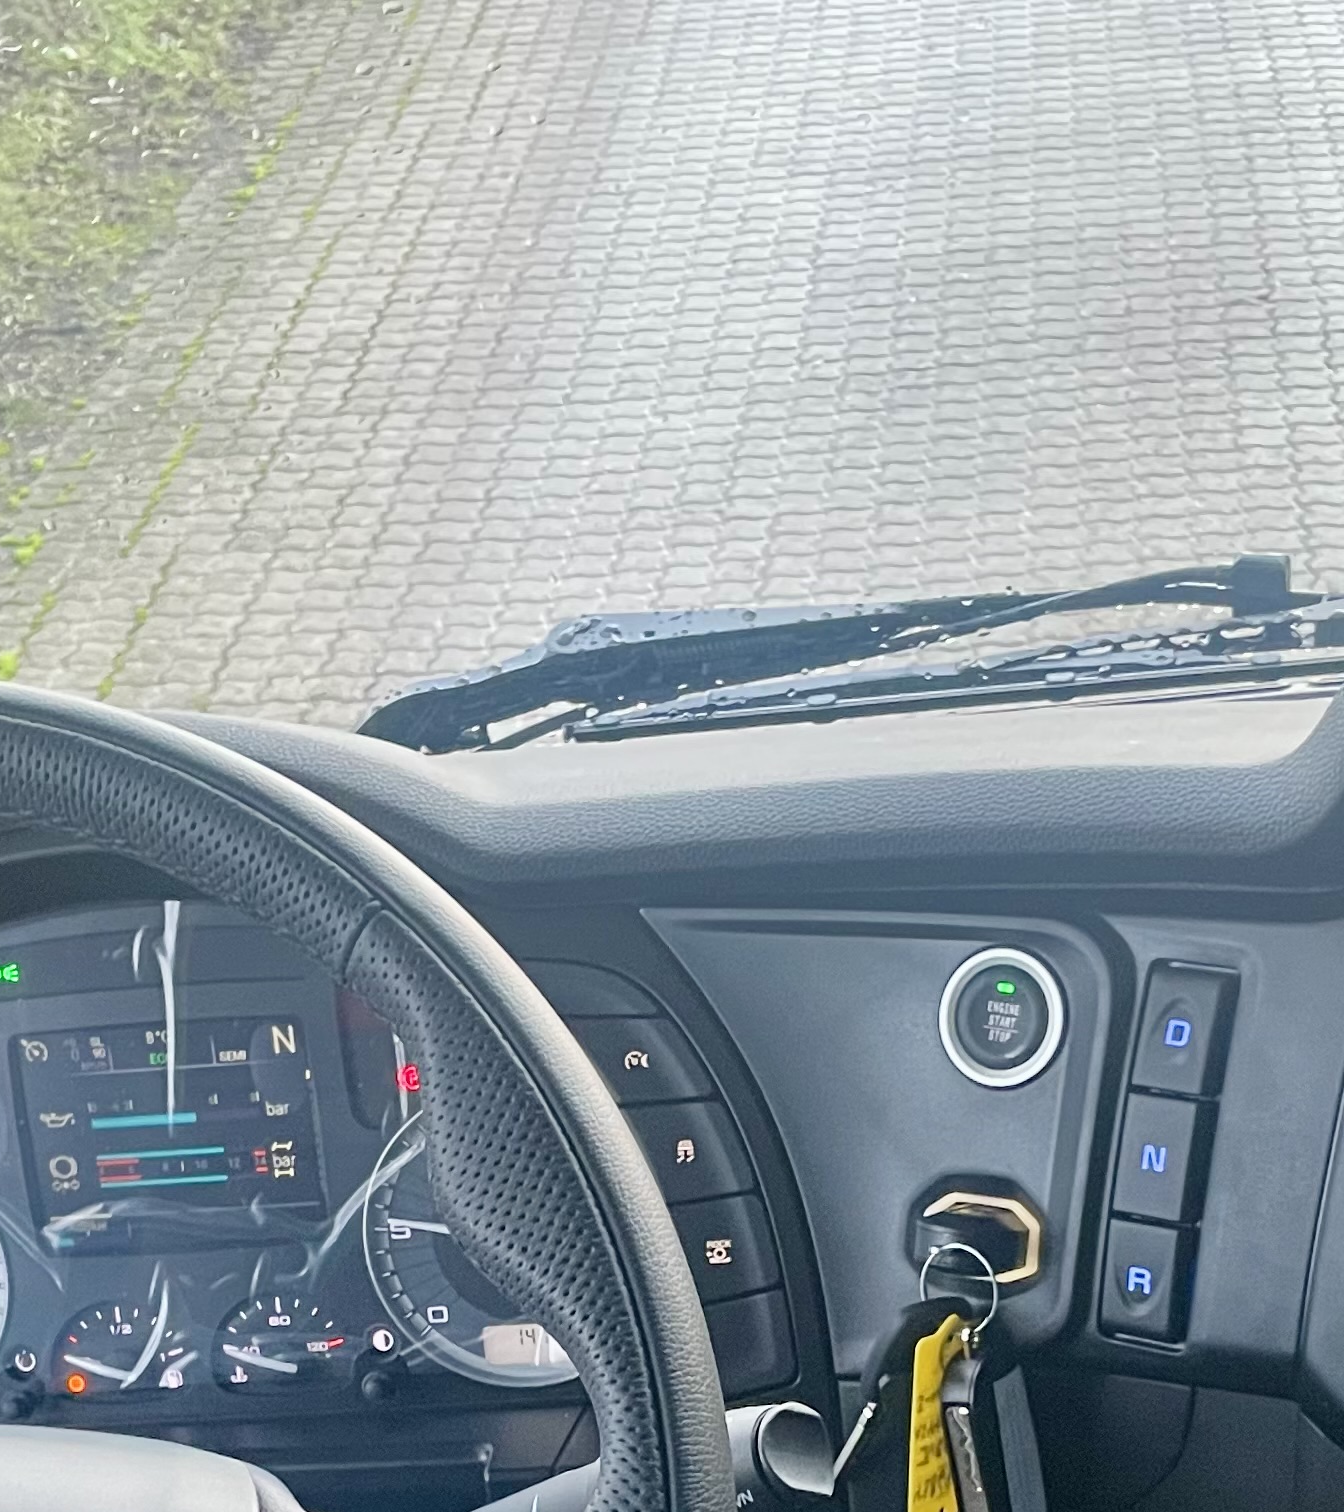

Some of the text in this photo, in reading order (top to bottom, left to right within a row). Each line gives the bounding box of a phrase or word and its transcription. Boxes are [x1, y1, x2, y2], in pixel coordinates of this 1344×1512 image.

[987, 1000, 1020, 1016] ENGINE
[988, 1014, 1017, 1028] START
[272, 1024, 296, 1054] N
[988, 1030, 1011, 1042] STOP
[1164, 1018, 1192, 1047] D
[219, 1050, 247, 1061] SEMI
[265, 1100, 289, 1117] bar
[1141, 1145, 1167, 1173] N
[389, 1219, 411, 1239] 5
[1127, 1265, 1152, 1295] R
[427, 1305, 449, 1323] 0
[109, 1323, 133, 1335] 1/2
